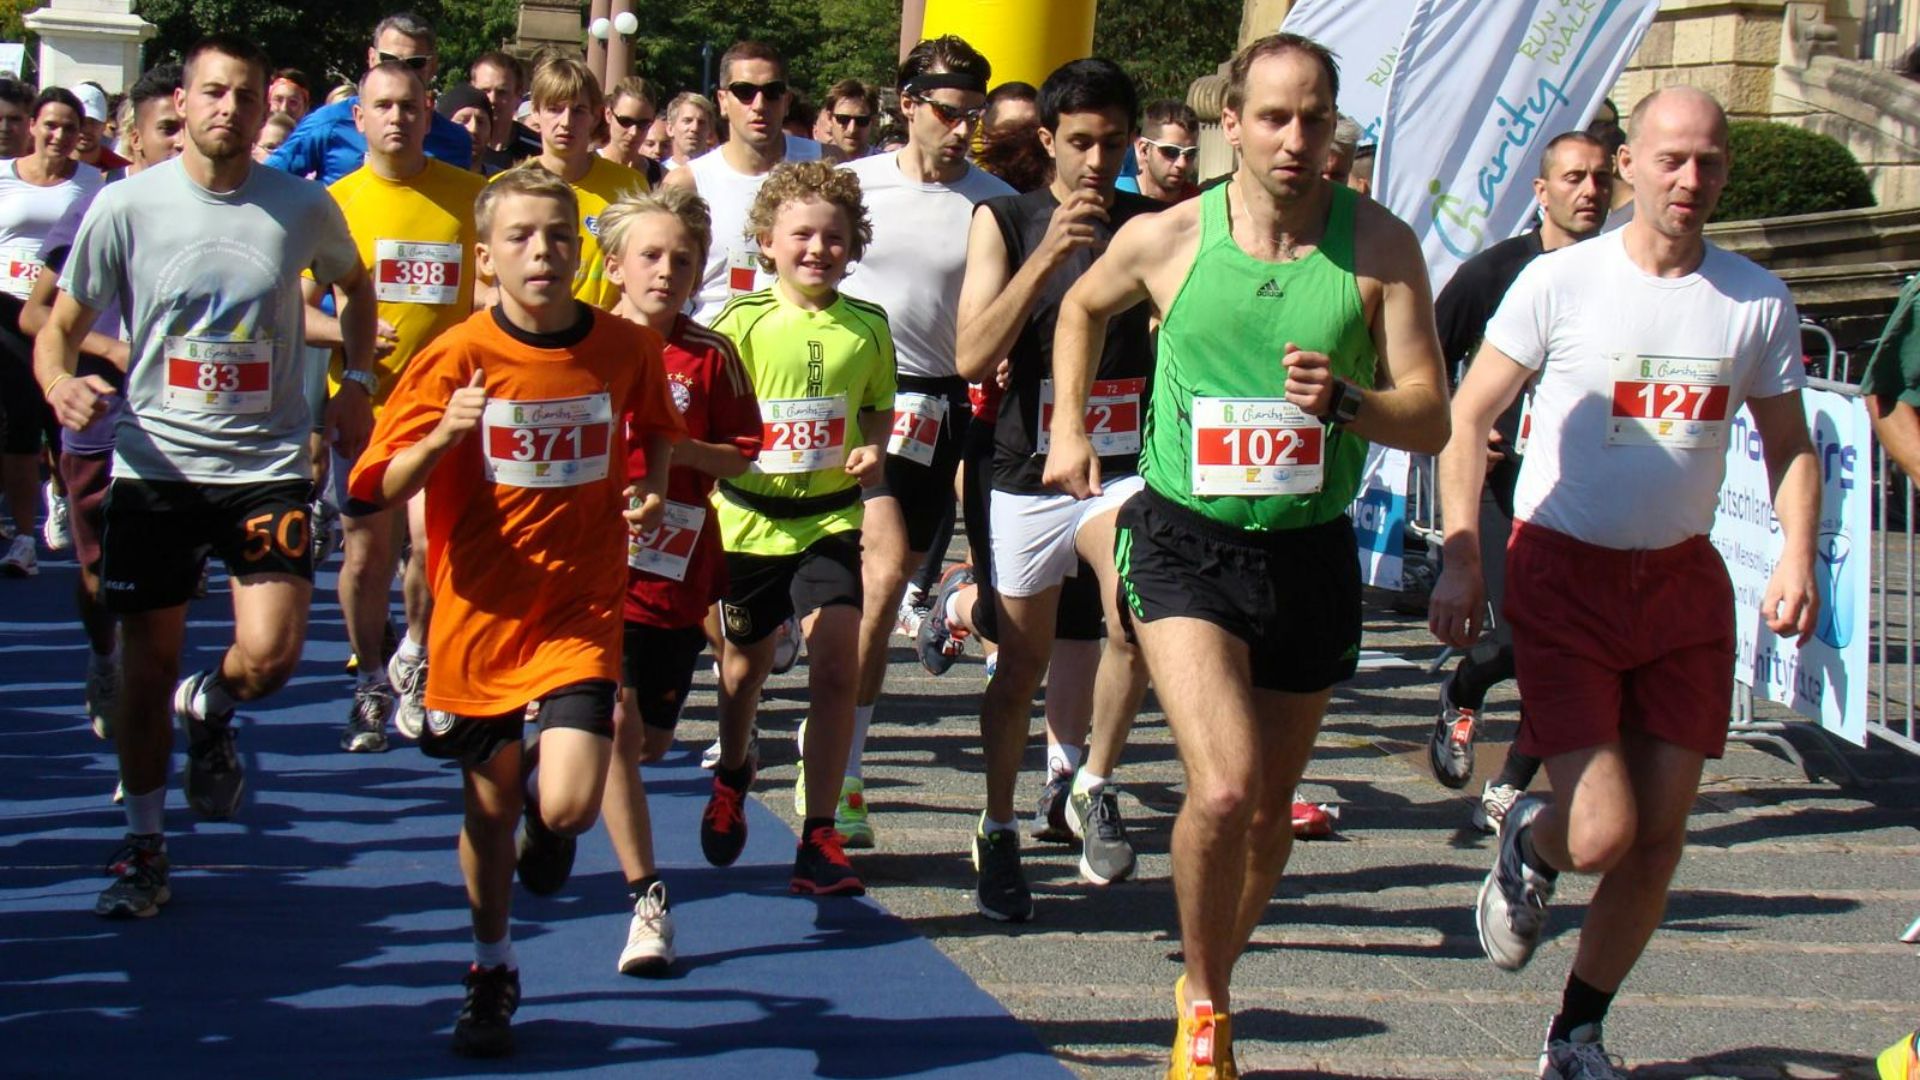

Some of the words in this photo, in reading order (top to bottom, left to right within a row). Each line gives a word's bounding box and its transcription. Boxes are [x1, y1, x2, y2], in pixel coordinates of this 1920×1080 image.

[1514, 10, 1558, 61] RUN
[1545, 0, 1597, 65] WALK
[1429, 77, 1570, 260] Charity
[395, 261, 445, 286] 398
[197, 363, 240, 392] 83
[1242, 403, 1283, 422] Charity
[1637, 383, 1713, 420] 127
[511, 426, 583, 462] 371
[771, 420, 831, 452] 285
[1222, 428, 1299, 466] 102
[244, 509, 309, 562] 50
